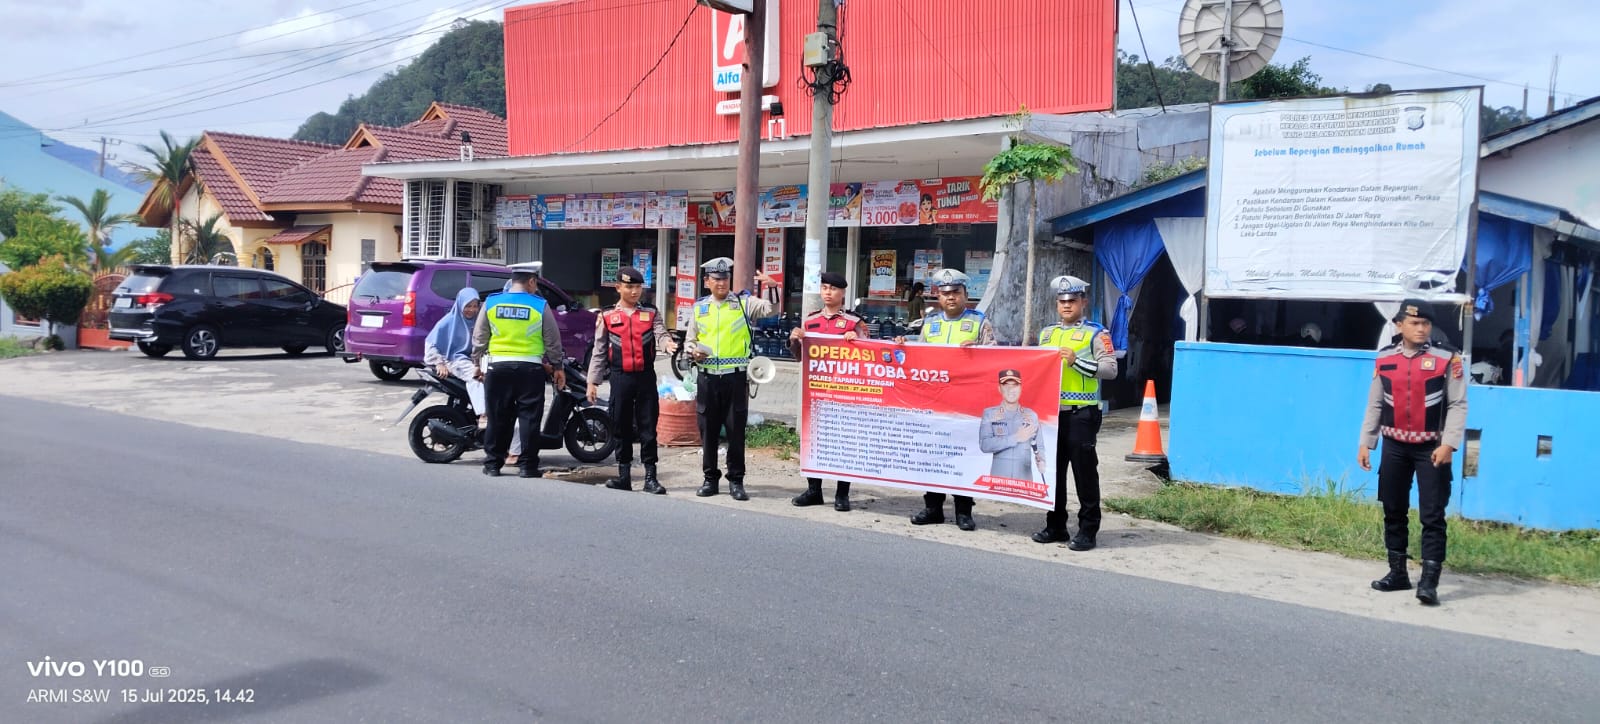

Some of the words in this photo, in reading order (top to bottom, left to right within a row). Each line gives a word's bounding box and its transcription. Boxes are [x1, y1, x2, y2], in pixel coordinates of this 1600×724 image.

[717, 72, 740, 84] Alfa
[1254, 148, 1286, 157] Sebelum
[1289, 147, 1330, 157] Bepergian
[1332, 144, 1393, 154] Meninggalkan
[1396, 142, 1426, 150] Rumah
[946, 181, 970, 194] TARIK
[1382, 184, 1418, 193] Bepergian
[936, 196, 960, 208] TUNAI
[866, 210, 898, 225] 3.000
[496, 306, 529, 319] POLISI
[808, 345, 876, 361] OPERASI
[809, 360, 860, 375] PATUH
[864, 364, 907, 380] TOBA
[910, 368, 950, 383] 2025
[834, 376, 866, 385] TAPANULI
[867, 379, 894, 387] TENGAH
